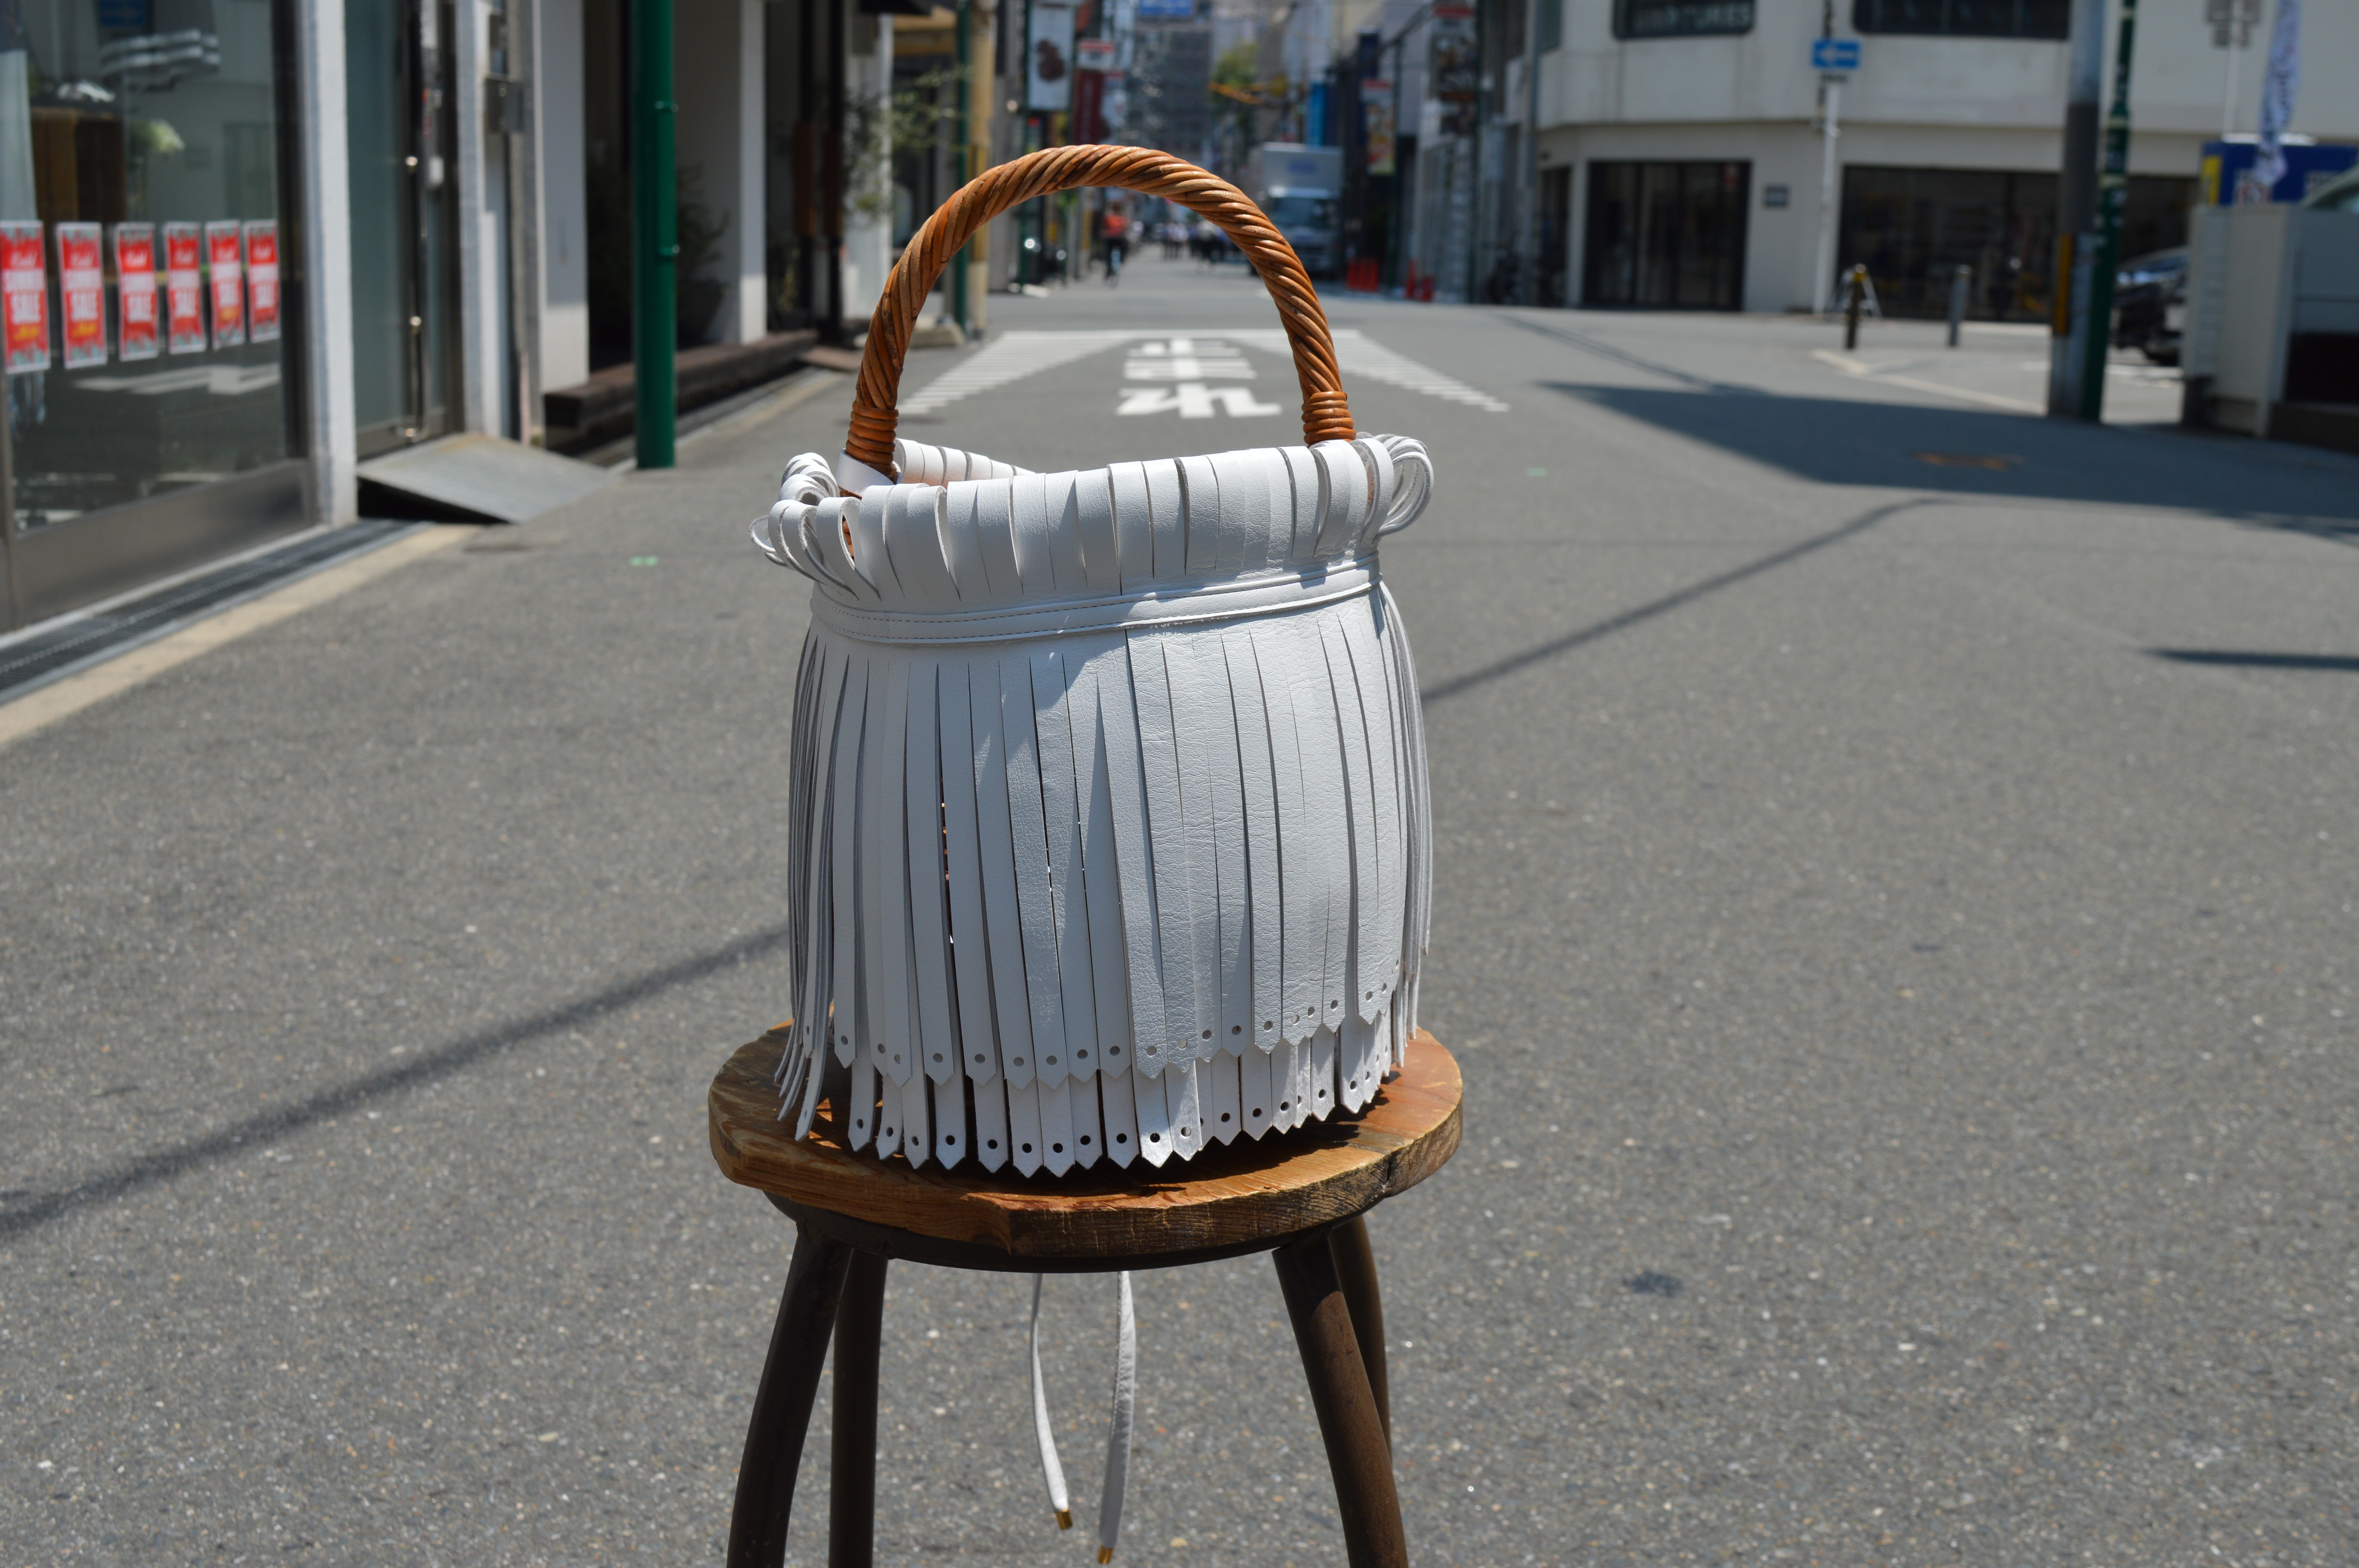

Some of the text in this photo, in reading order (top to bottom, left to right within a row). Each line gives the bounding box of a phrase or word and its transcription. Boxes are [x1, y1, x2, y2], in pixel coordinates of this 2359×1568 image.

[12, 293, 41, 324] SALE
[72, 291, 98, 321] SALE
[128, 295, 153, 323] SALE
